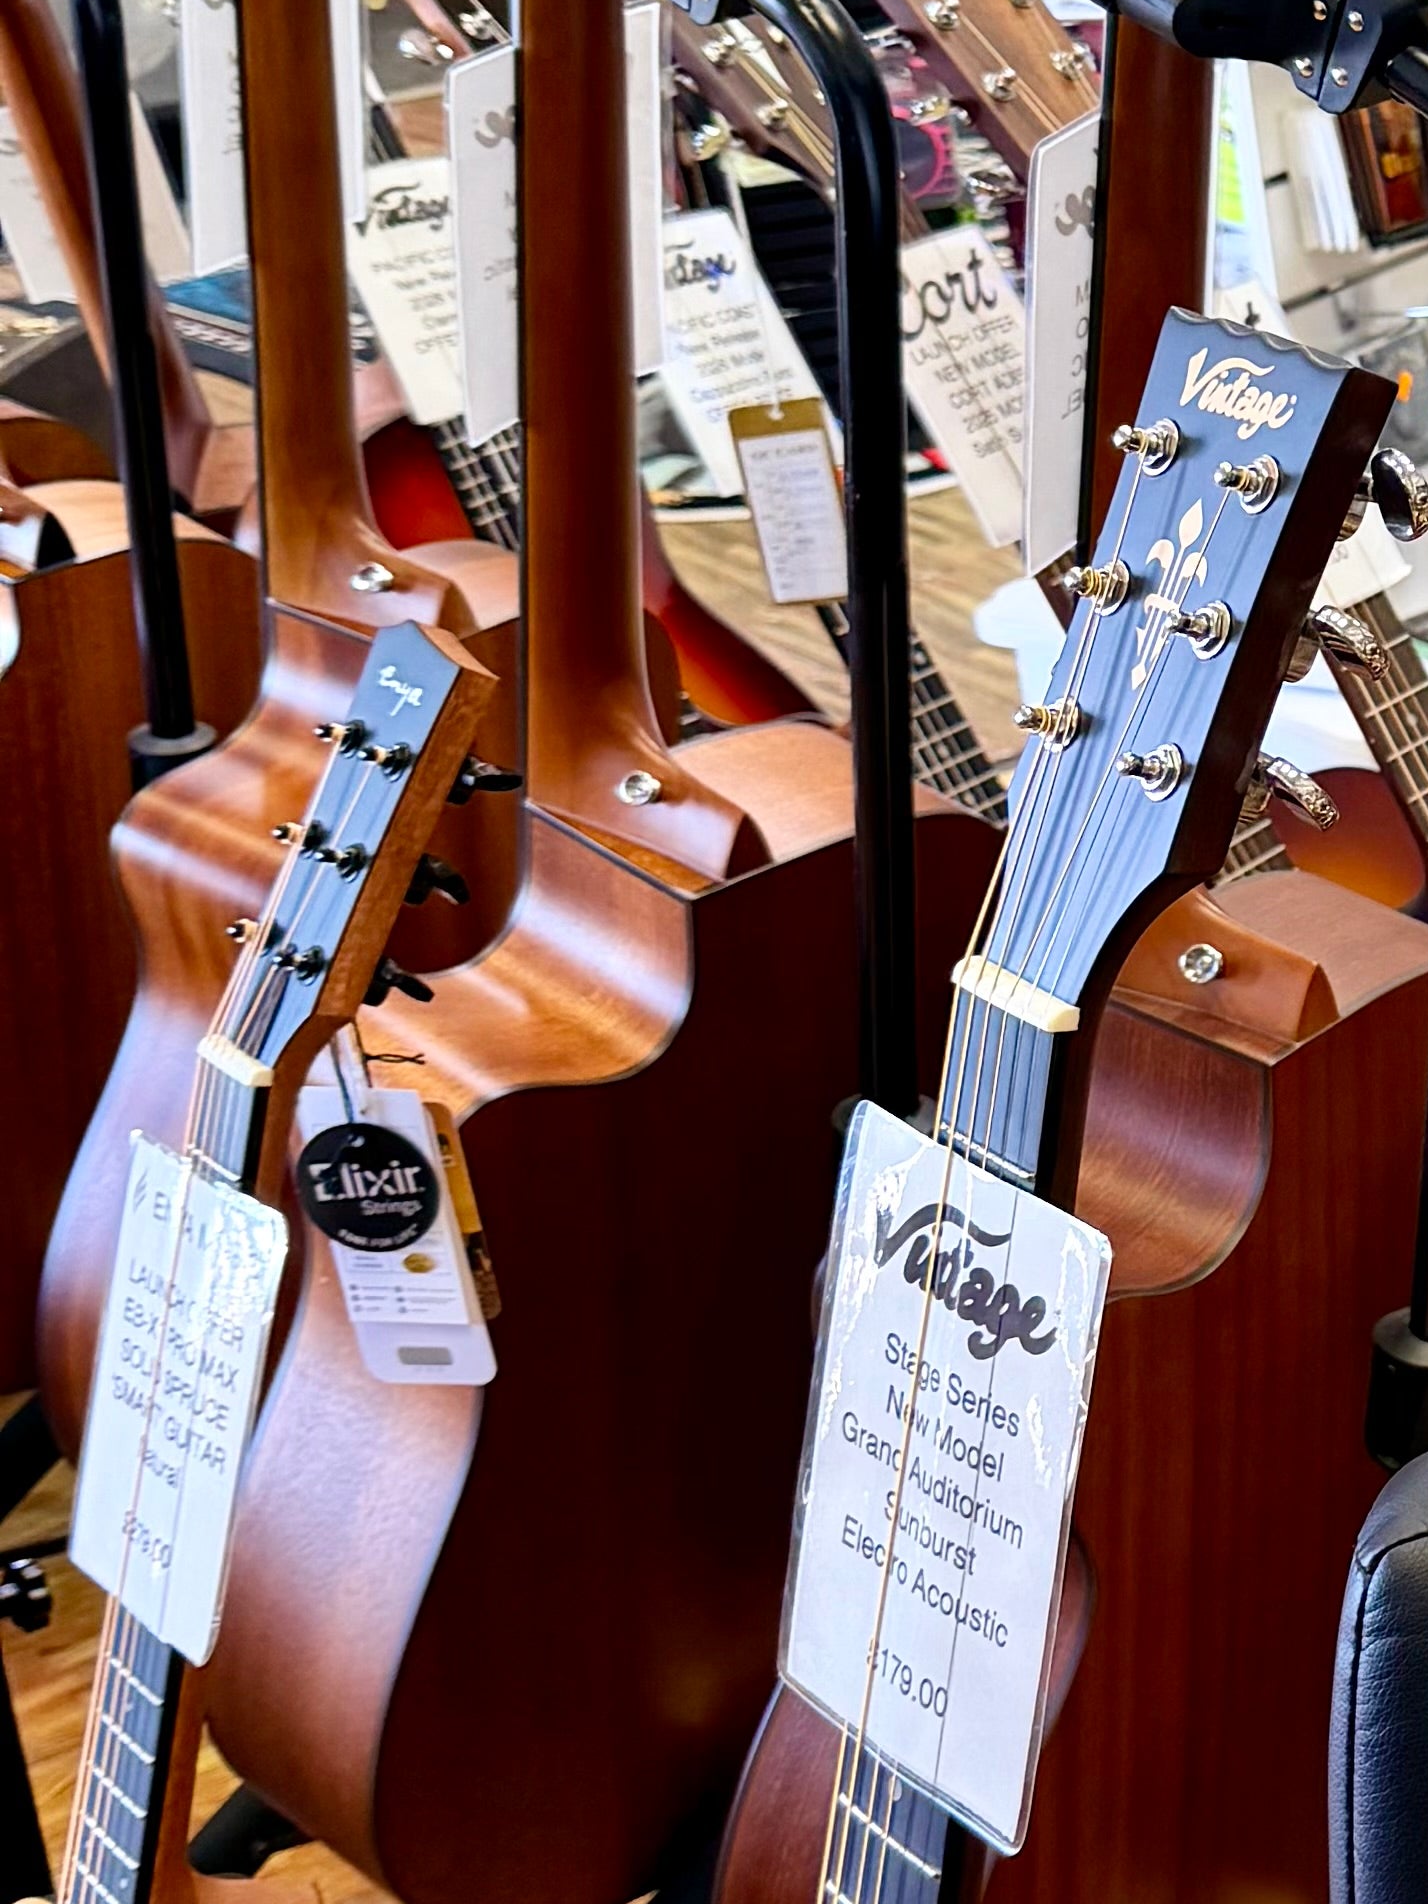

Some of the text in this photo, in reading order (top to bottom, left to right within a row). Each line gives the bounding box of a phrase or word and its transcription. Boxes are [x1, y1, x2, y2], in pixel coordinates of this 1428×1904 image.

[1178, 345, 1298, 441] Vintage
[308, 1159, 424, 1202] Elixir
[874, 1202, 1060, 1362] Vintage
[884, 1331, 1022, 1439] Stage Series
[885, 1382, 1007, 1484] New Model
[884, 1488, 977, 1579] Sunburst
[908, 1453, 1026, 1551] Auditorium
[840, 1513, 1011, 1650] Elecro Acoustic
